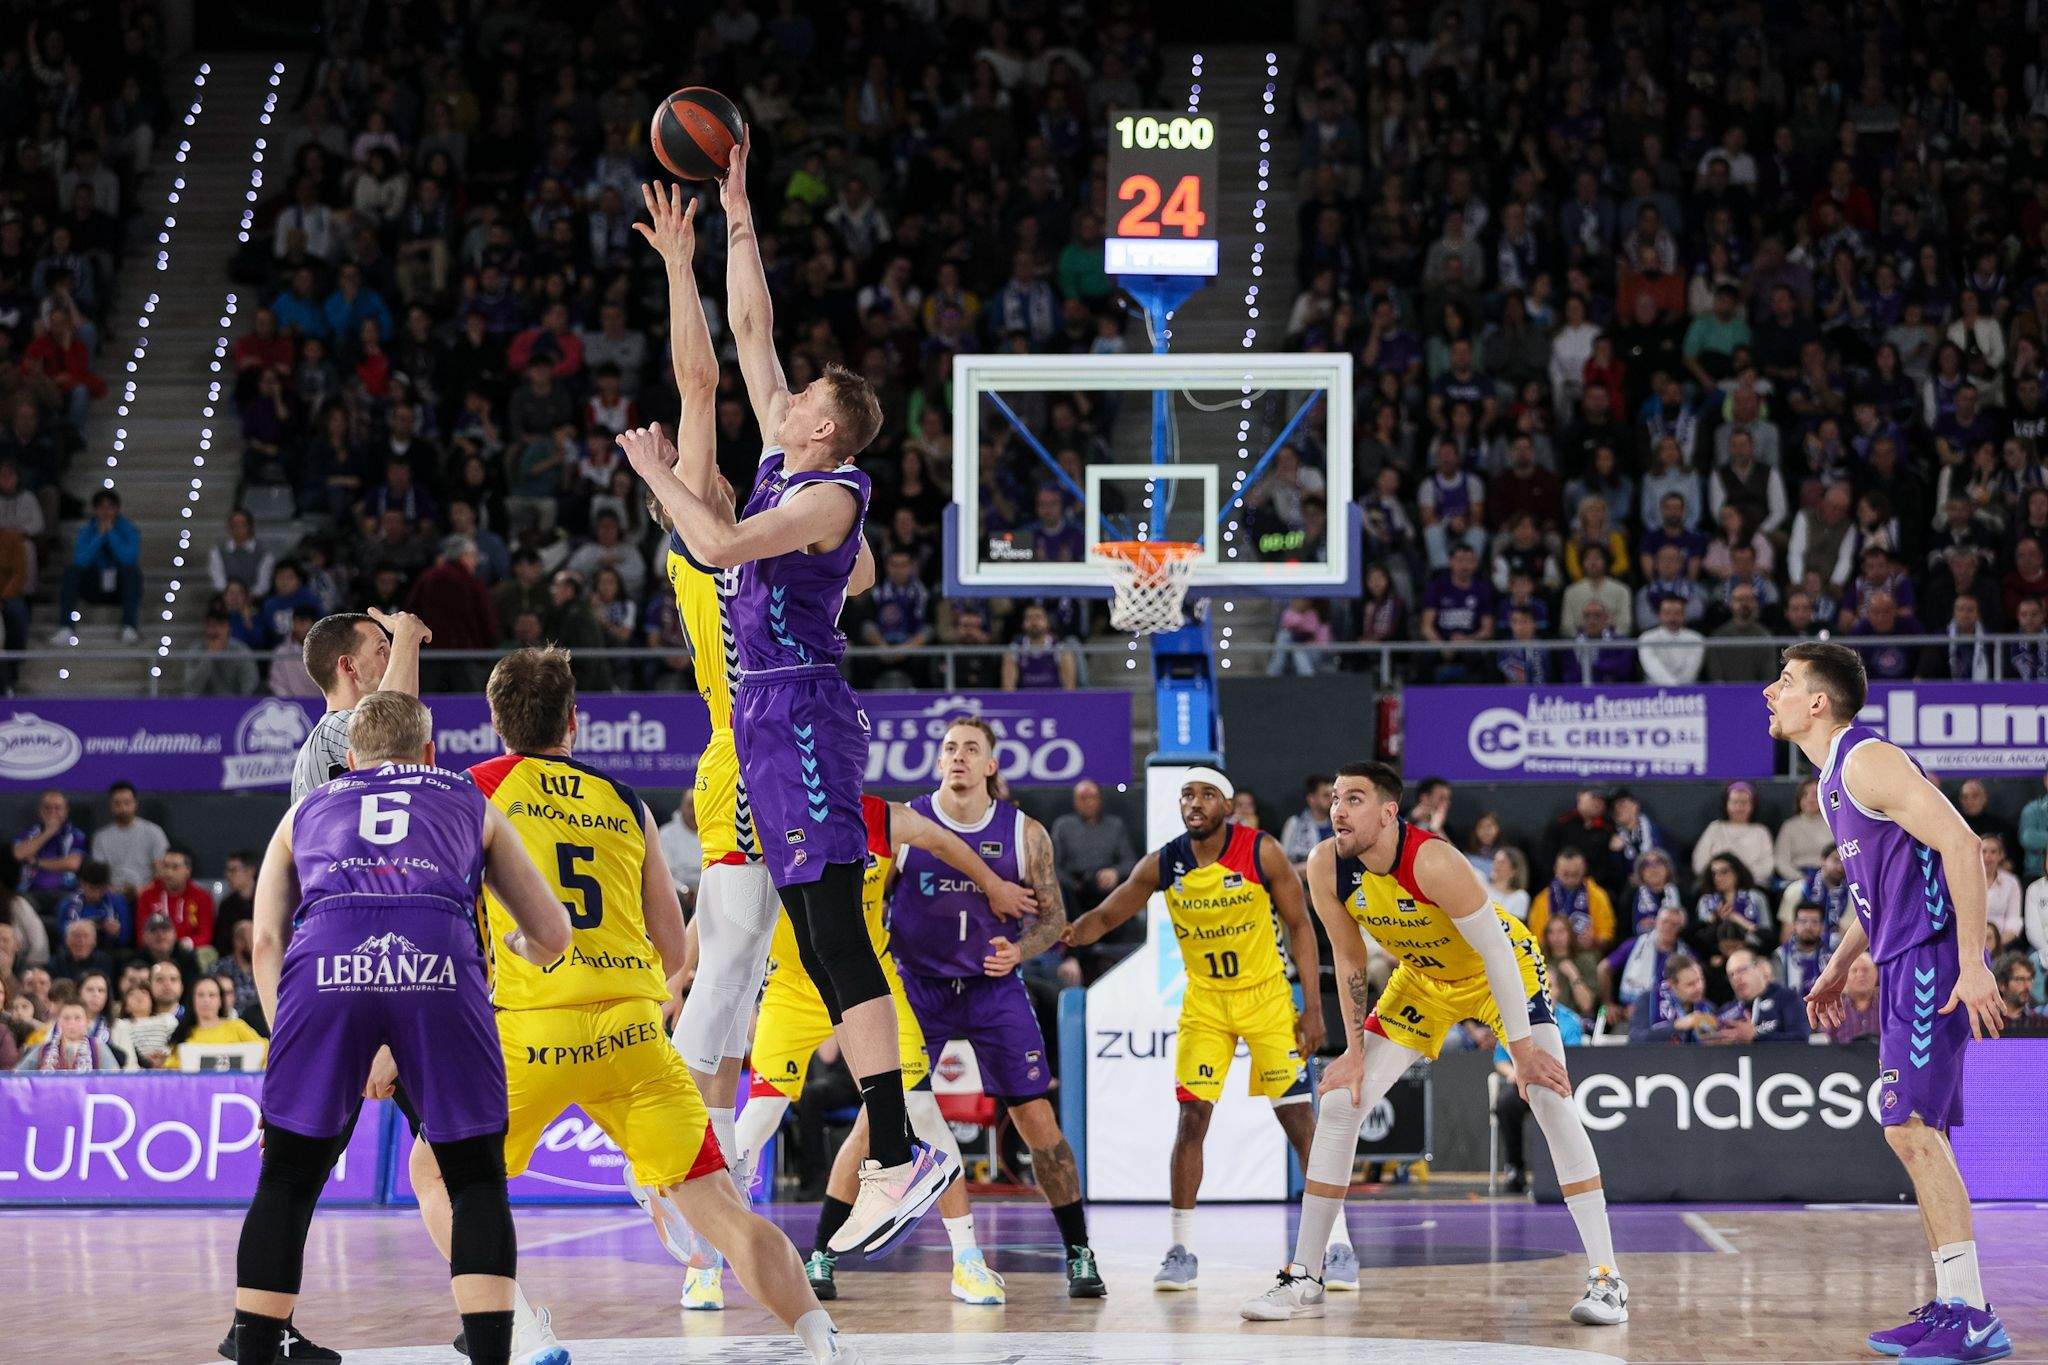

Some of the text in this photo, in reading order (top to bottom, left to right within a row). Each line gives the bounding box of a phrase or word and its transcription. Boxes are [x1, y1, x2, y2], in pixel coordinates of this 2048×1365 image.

[1116, 116, 1214, 150] 10:00
[1117, 174, 1206, 238] 24
[1526, 730, 1555, 747] EL
[1566, 727, 1671, 748] CRISTO
[541, 773, 585, 800] LUZ
[359, 790, 412, 845] 6
[556, 842, 604, 930] 5
[1182, 891, 1255, 910] MORABANC
[958, 910, 968, 942] 1
[316, 953, 457, 986] LEBANZA
[1205, 950, 1240, 979] 10
[364, 985, 398, 993] MINERAL
